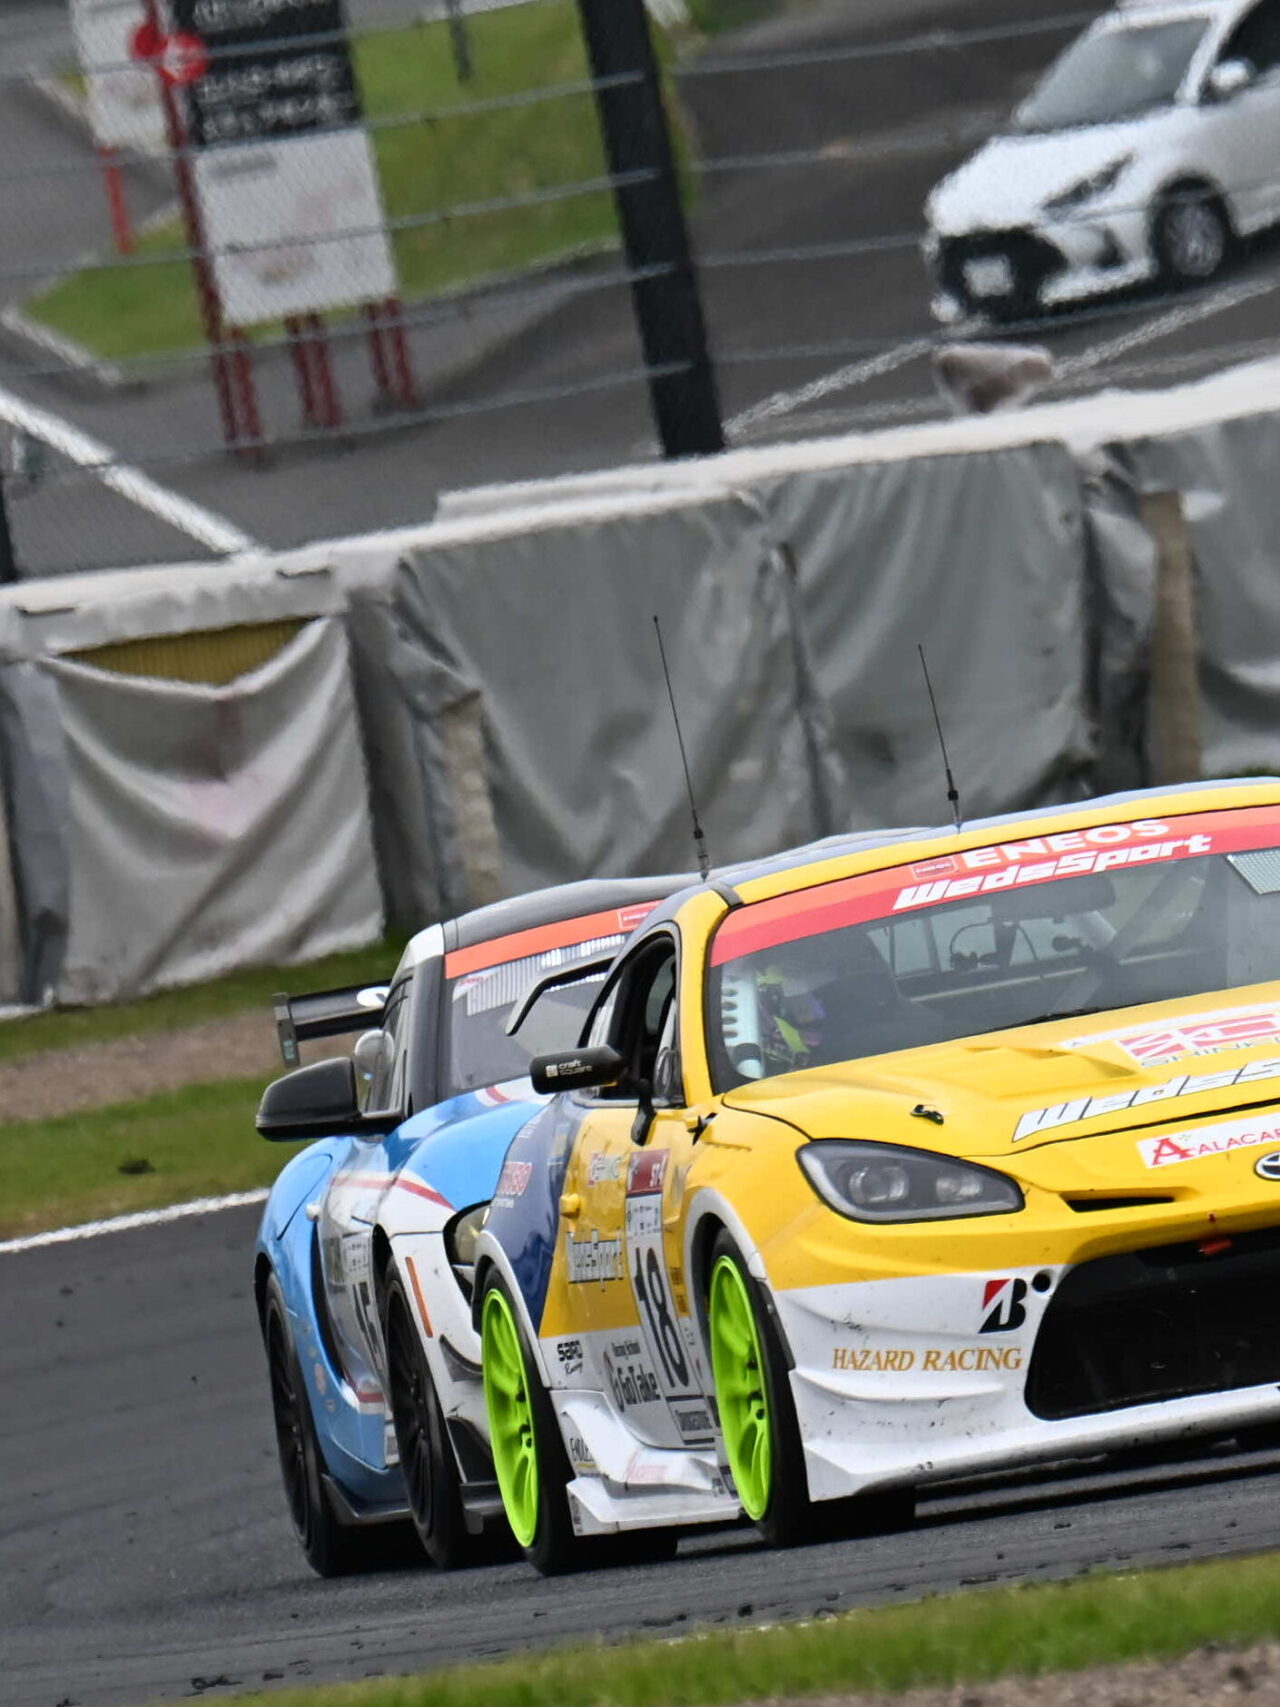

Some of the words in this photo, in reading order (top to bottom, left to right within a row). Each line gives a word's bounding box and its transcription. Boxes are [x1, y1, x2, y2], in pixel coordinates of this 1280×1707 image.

[892, 835, 1212, 910] WedsSport
[960, 818, 1171, 869] ENEOS
[634, 1247, 689, 1388] 18
[831, 1348, 915, 1371] HAZARD
[921, 1347, 1023, 1371] RACING
